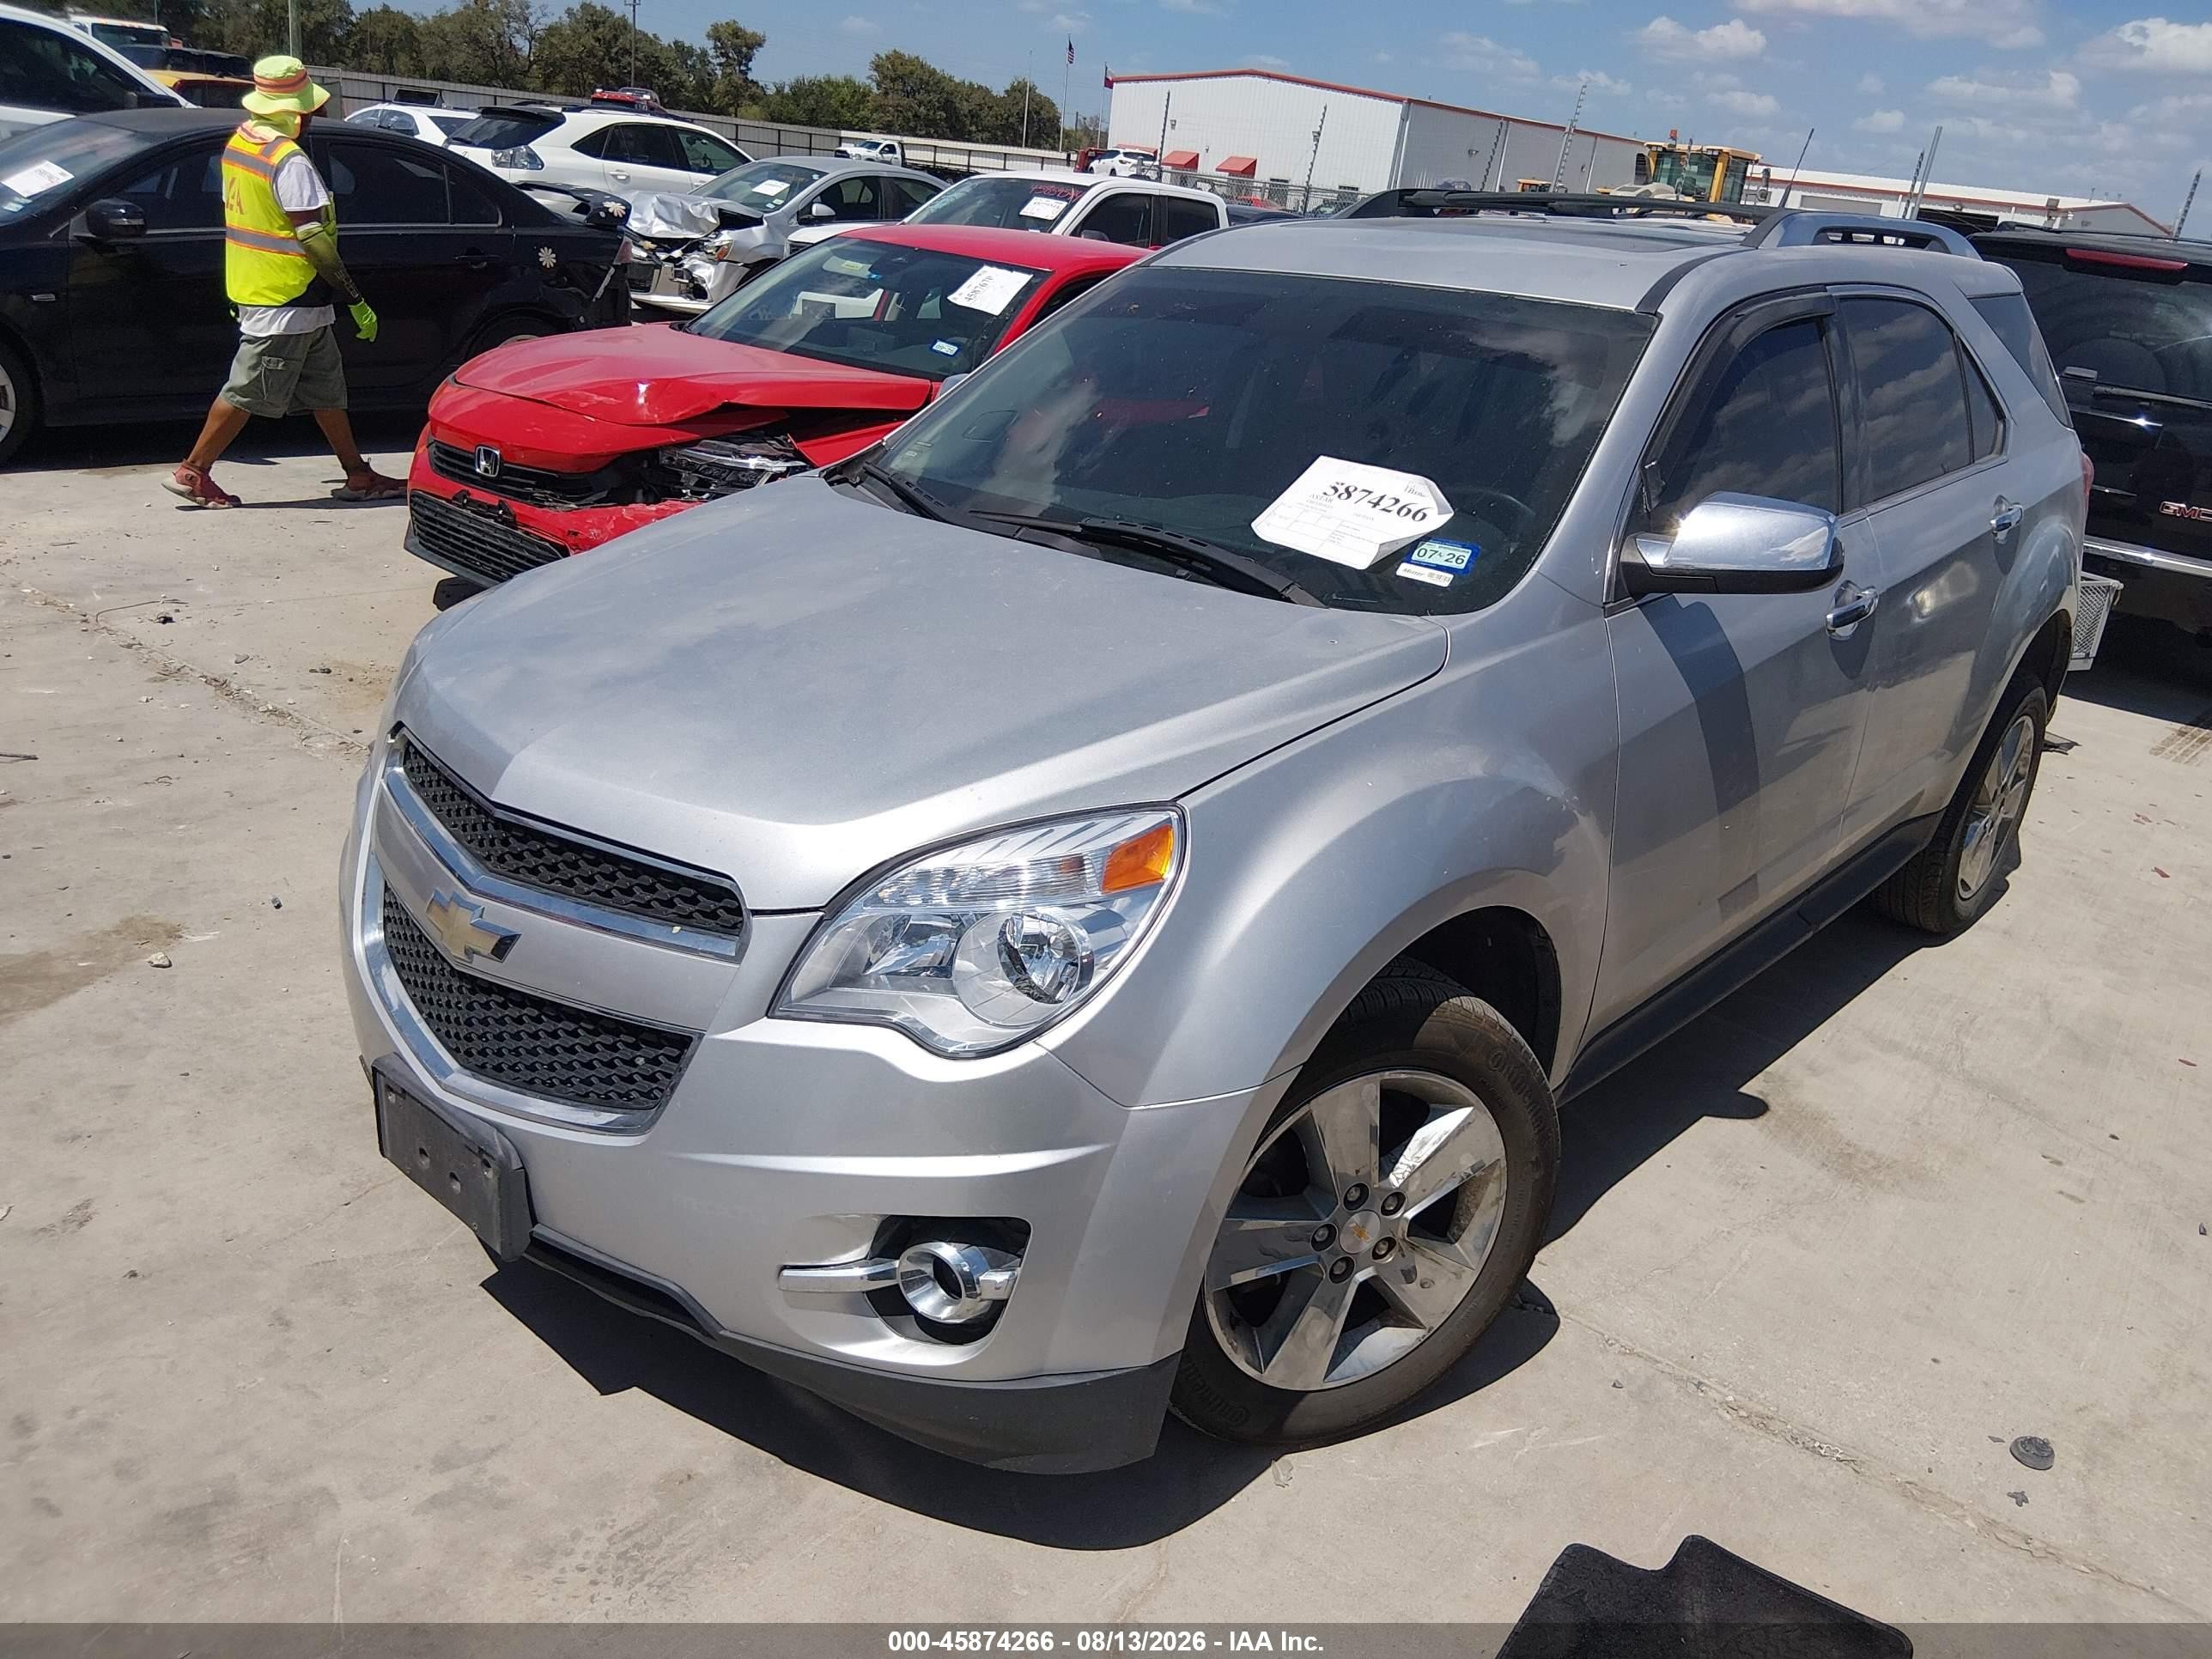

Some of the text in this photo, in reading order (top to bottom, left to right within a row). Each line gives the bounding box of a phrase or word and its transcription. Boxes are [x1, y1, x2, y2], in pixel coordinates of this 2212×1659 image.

[1322, 481, 1432, 522] 5874266
[2159, 501, 2212, 522] GMC
[1416, 547, 1439, 559] 07
[1443, 552, 1466, 565] 26
